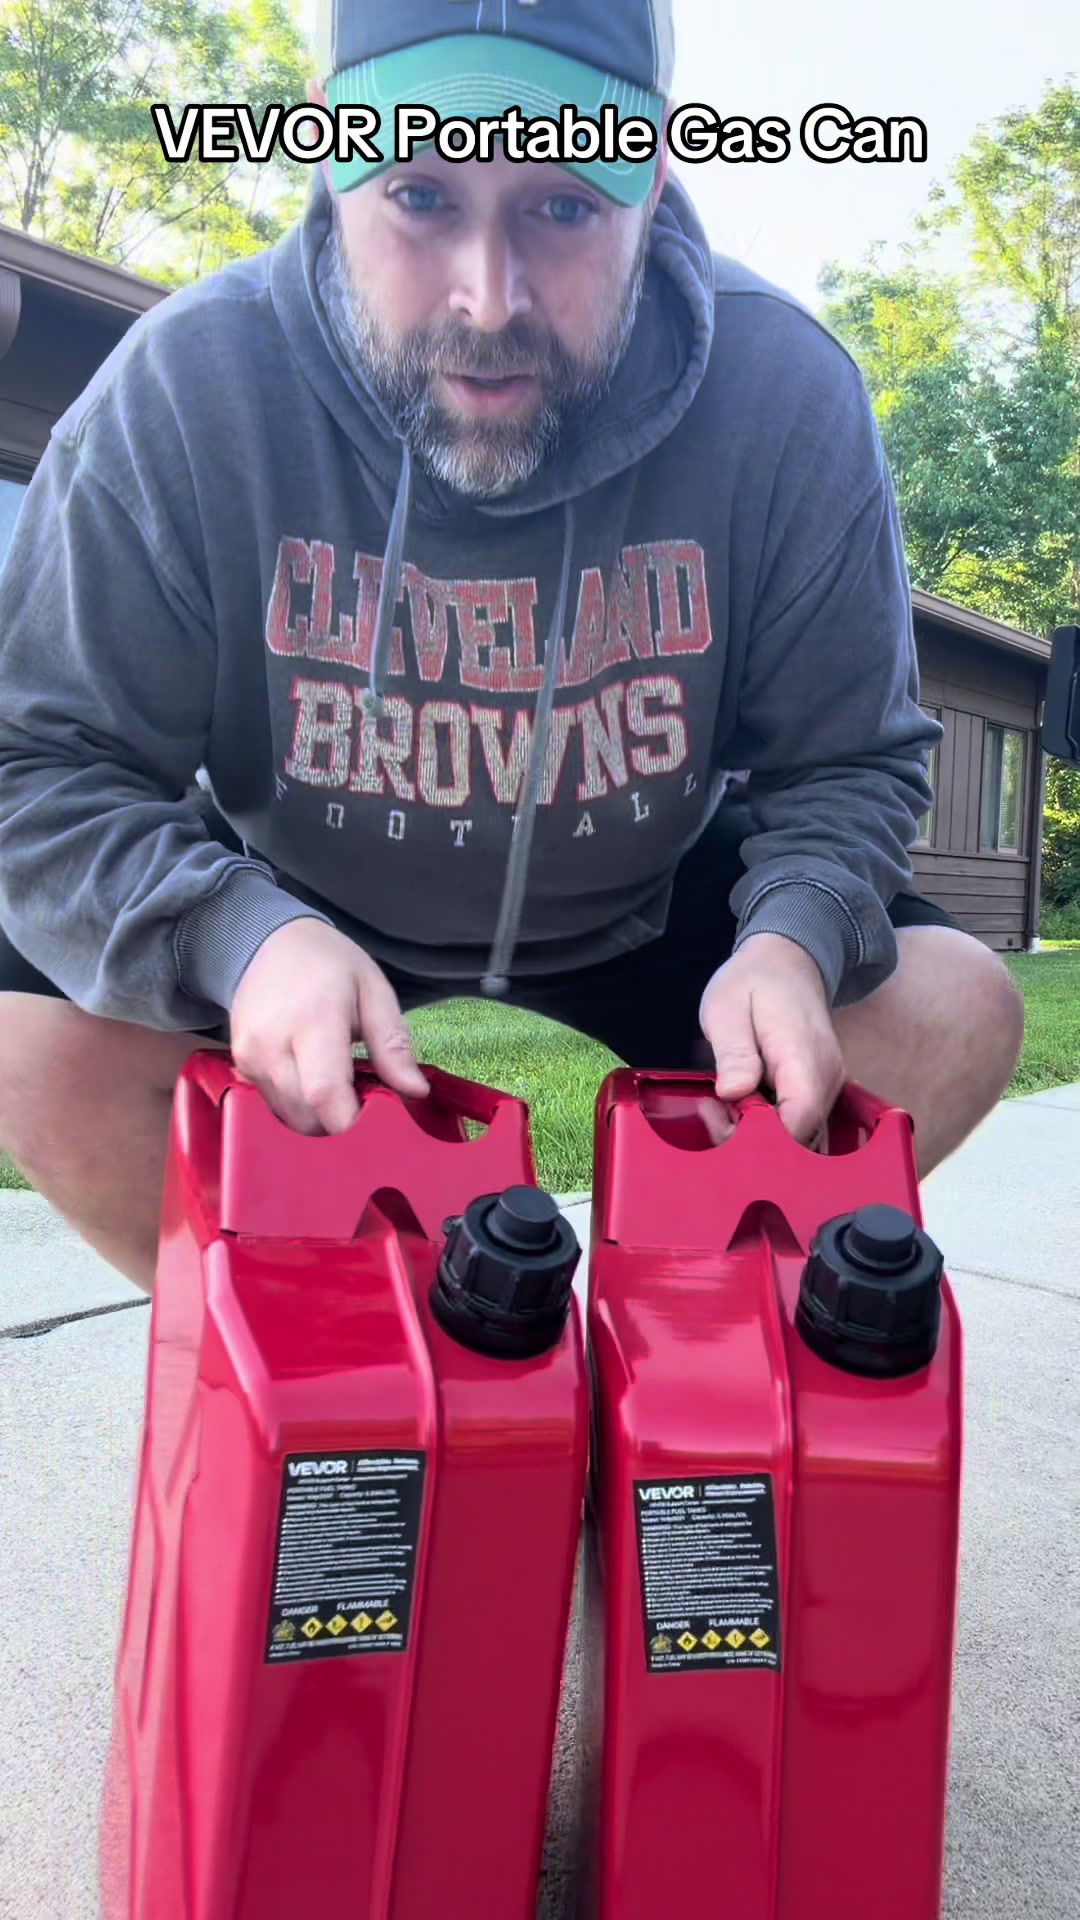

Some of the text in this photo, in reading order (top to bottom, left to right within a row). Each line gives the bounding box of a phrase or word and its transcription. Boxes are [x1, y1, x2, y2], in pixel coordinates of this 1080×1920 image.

[284, 674, 689, 807] BROWNS
[275, 772, 697, 847] FOOTALL
[288, 1460, 348, 1476] VEVOR
[638, 1485, 694, 1500] VEVOR
[281, 1599, 390, 1617] DANGER FLAMMABLE
[656, 1617, 760, 1631] DANGER FLAMMABLE
